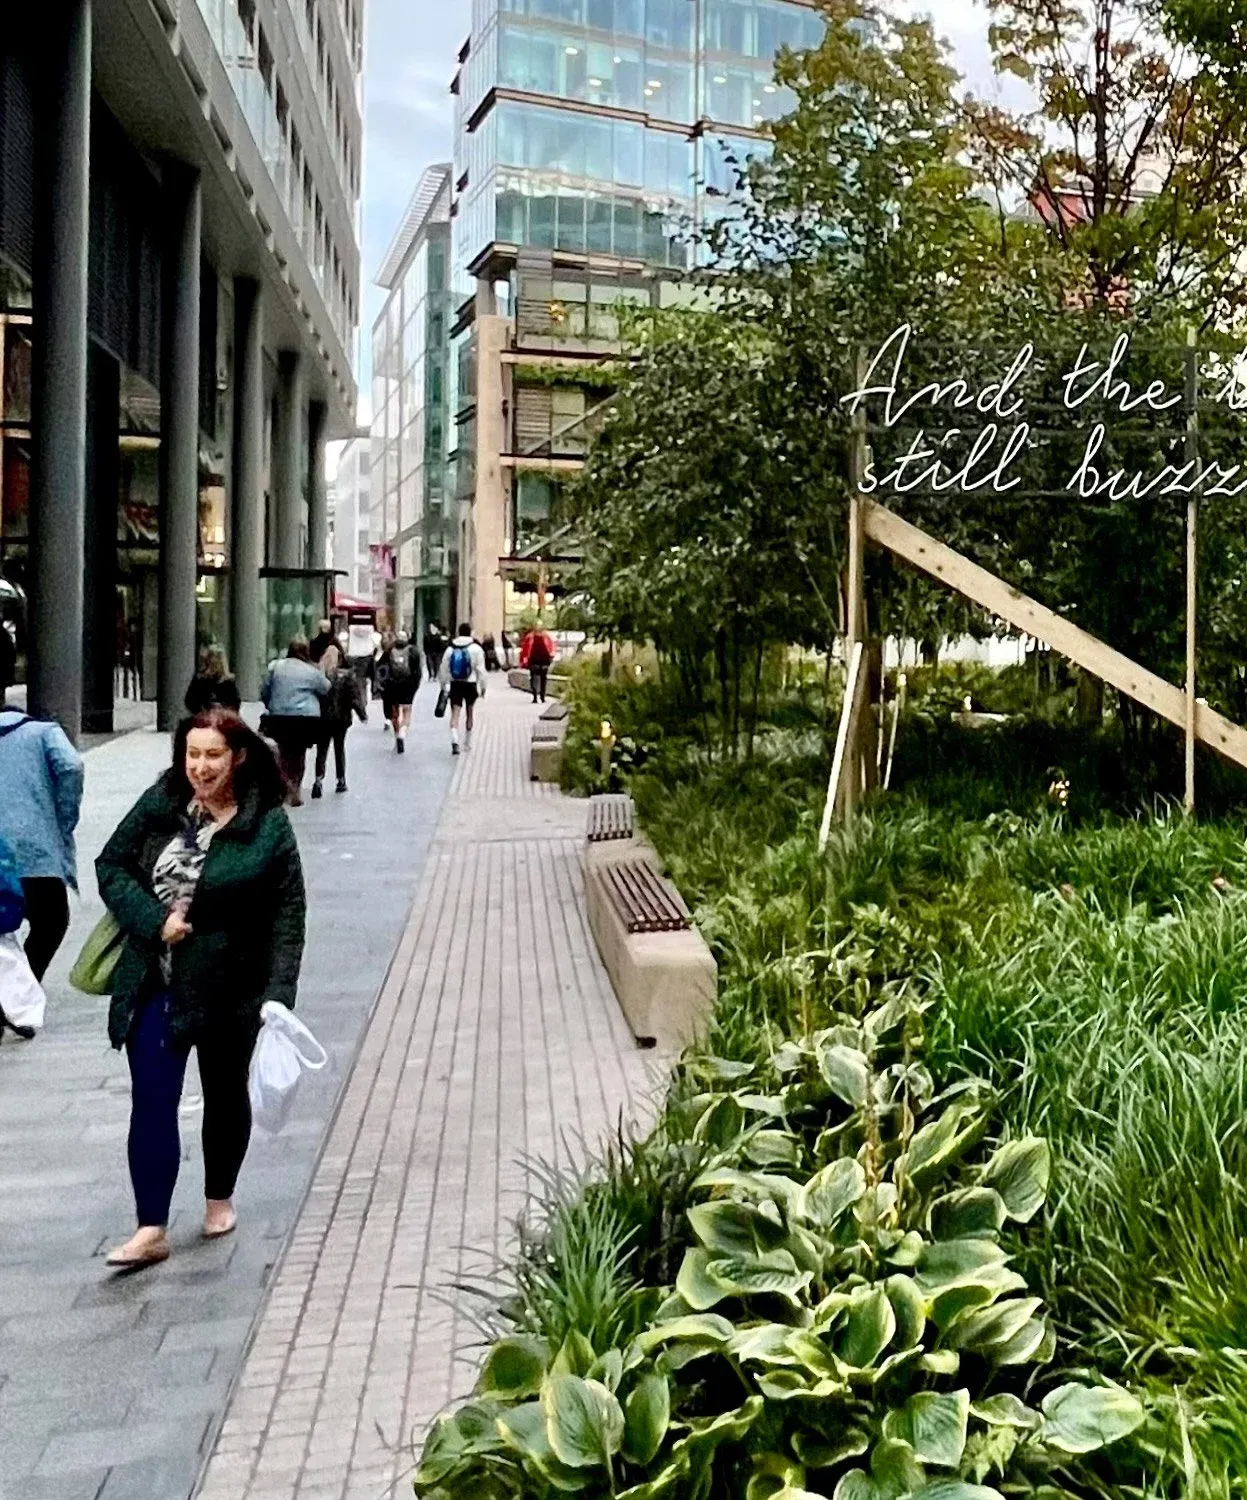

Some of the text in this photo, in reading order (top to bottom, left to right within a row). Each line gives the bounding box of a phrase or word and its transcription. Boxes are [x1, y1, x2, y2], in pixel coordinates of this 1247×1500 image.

[840, 323, 1033, 426] And
[1062, 333, 1182, 411] the
[858, 422, 1029, 493] still
